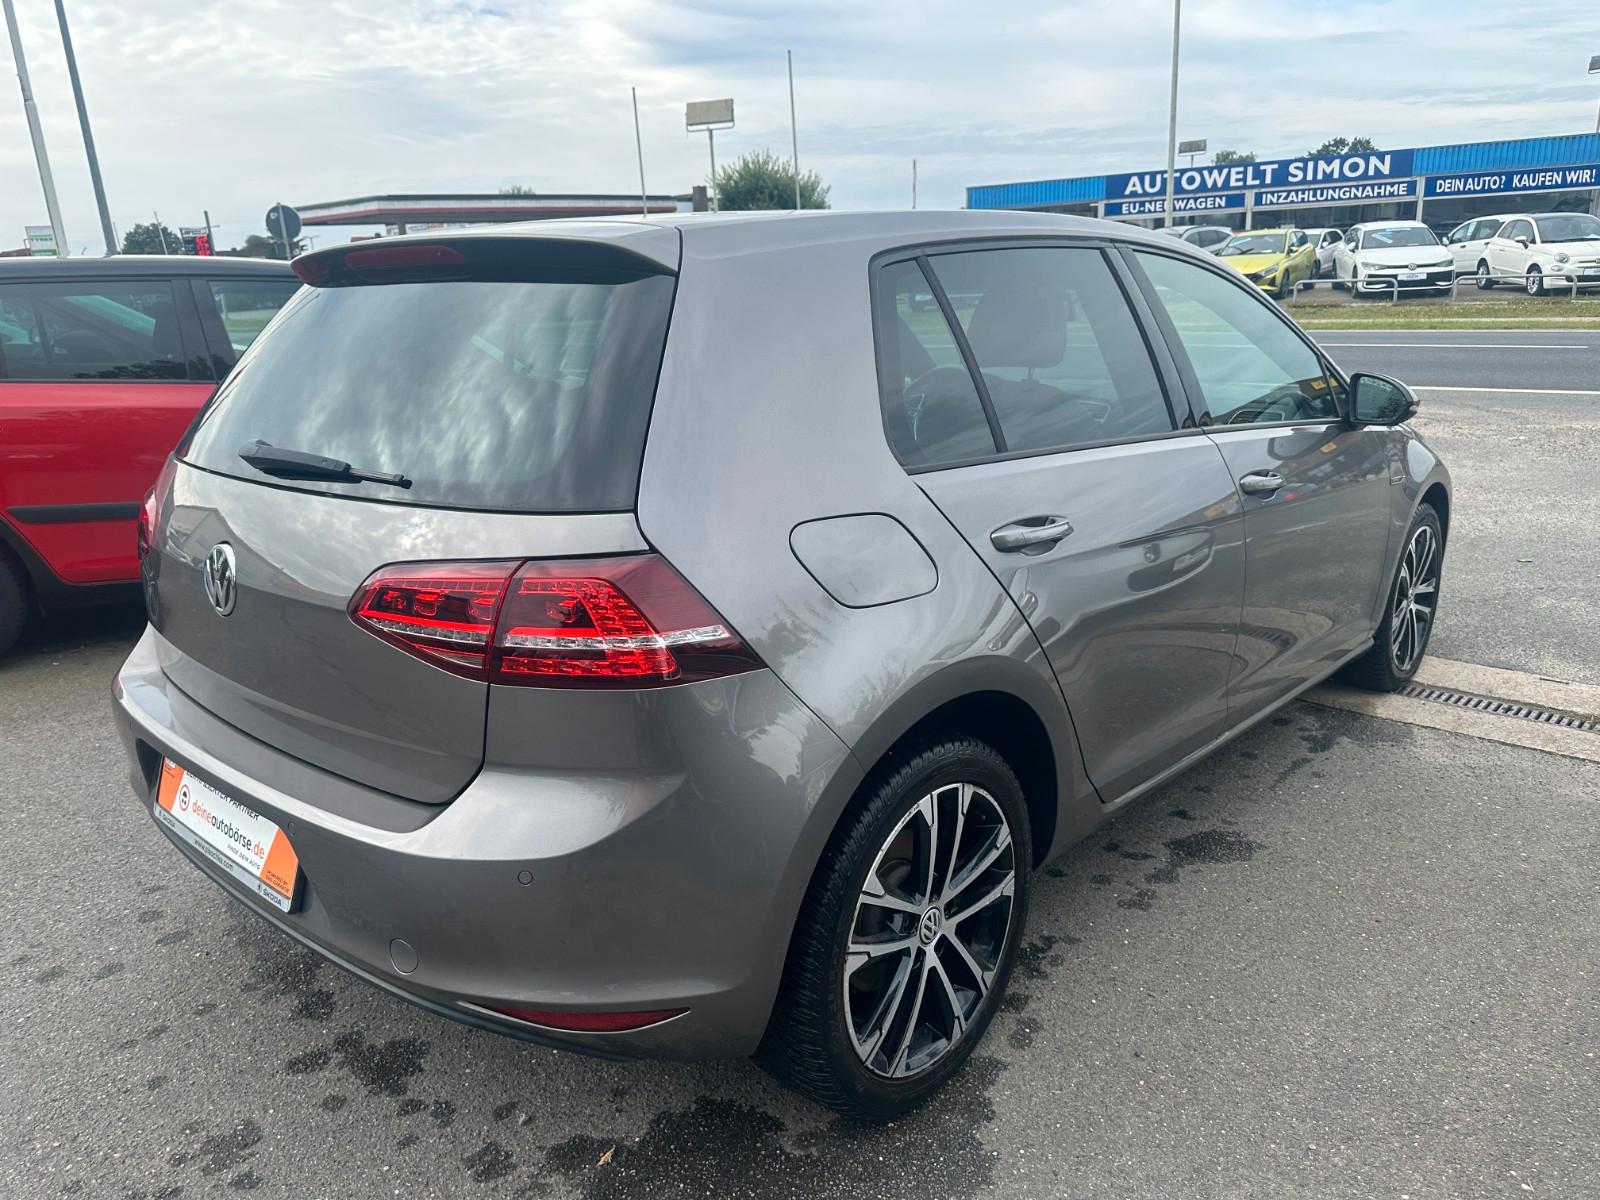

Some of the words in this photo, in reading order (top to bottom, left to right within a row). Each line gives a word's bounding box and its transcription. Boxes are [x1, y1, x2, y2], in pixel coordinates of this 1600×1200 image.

[1287, 154, 1391, 183] SIMON
[1436, 178, 1464, 193] DEIN
[1464, 175, 1506, 191] AUTO?
[1512, 171, 1562, 188] KAUFEN
[1565, 168, 1596, 184] WIR!
[1261, 183, 1408, 205] INZAHLUNGNAHME
[192, 800, 265, 859] deineautobörse.de
